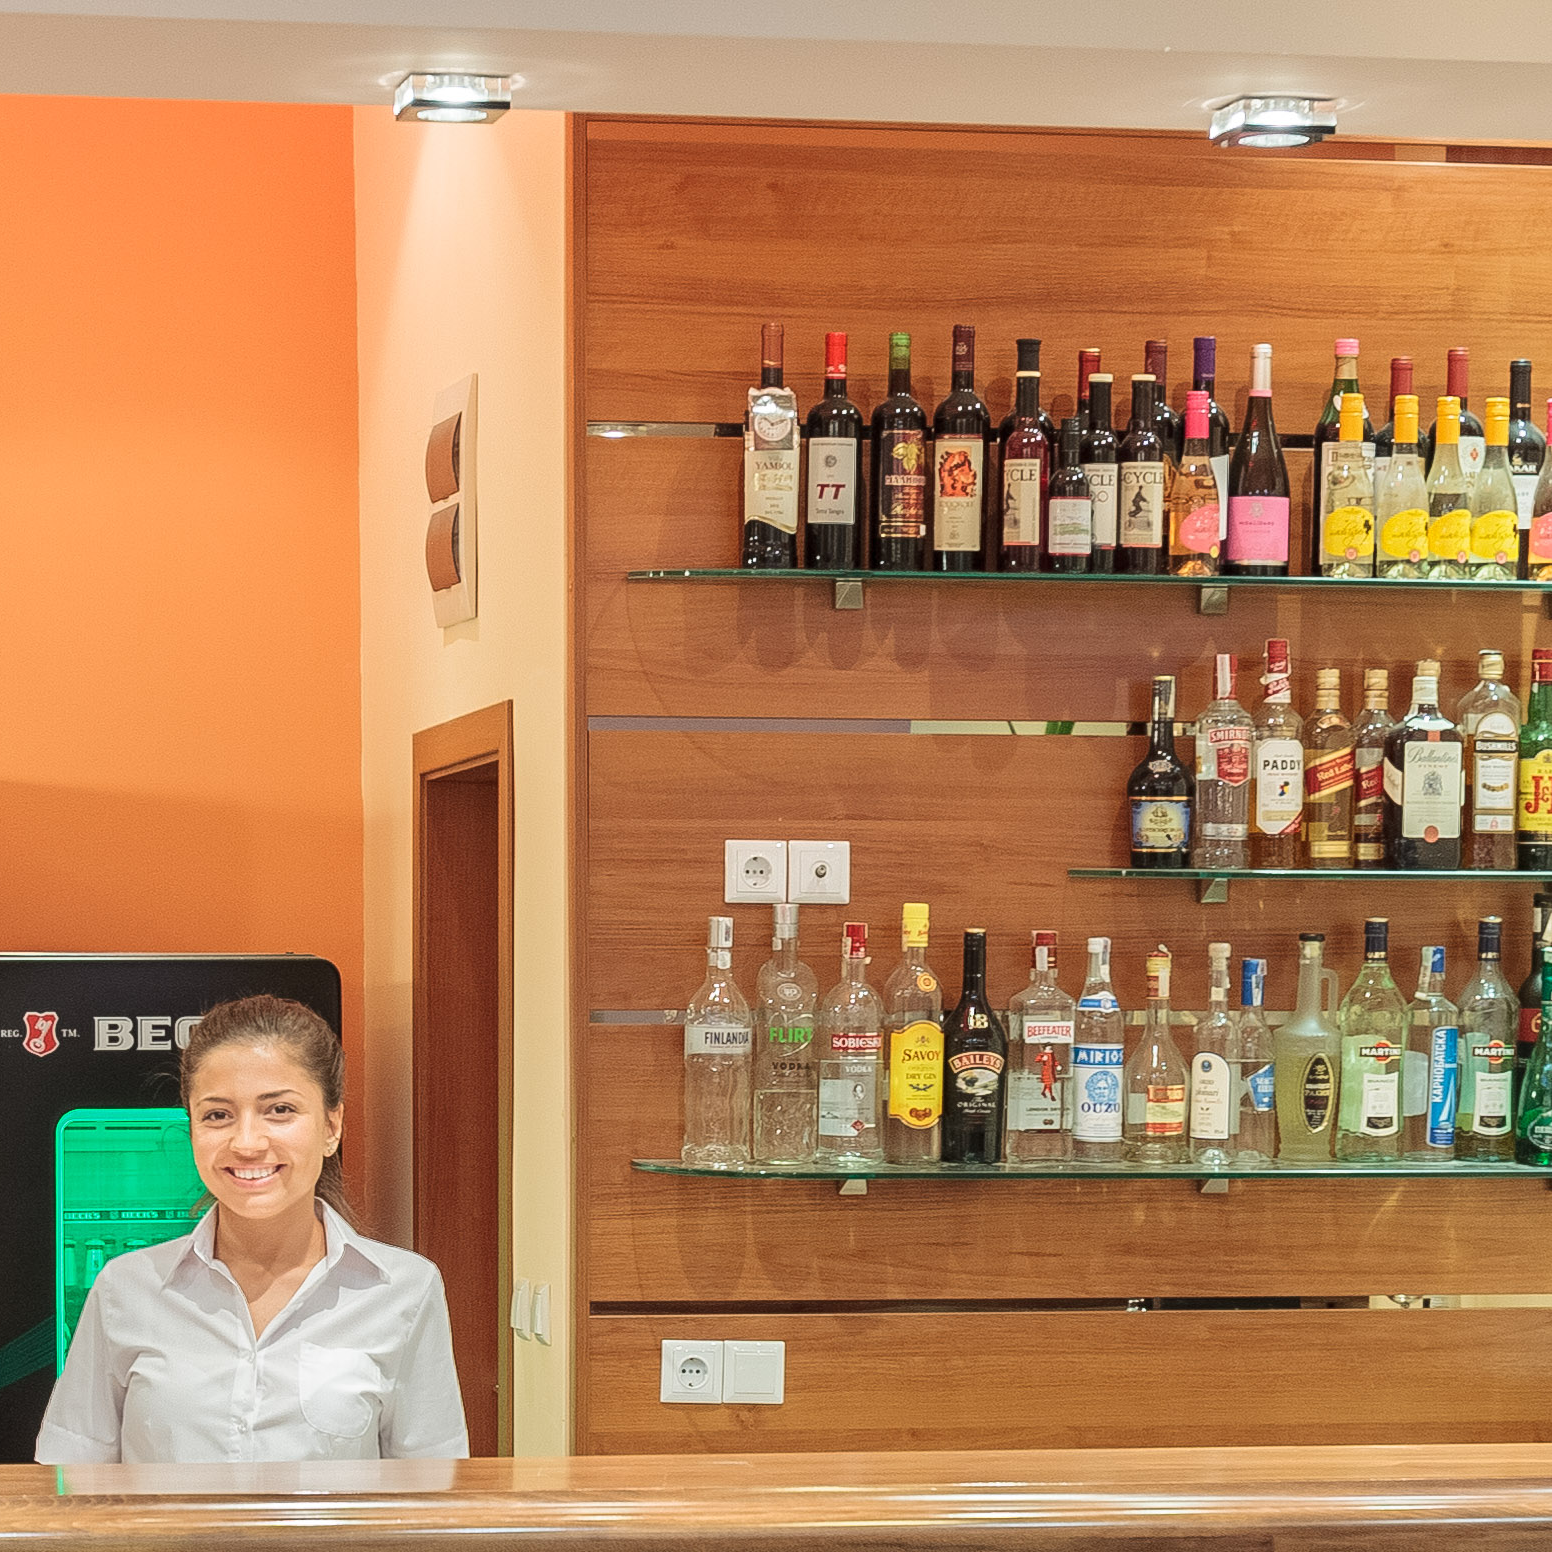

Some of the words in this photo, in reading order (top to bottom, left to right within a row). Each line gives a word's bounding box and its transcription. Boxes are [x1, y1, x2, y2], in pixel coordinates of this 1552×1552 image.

[754, 461, 794, 471] YAMBOL
[1510, 465, 1538, 473] AKAR
[816, 483, 846, 500] TT
[1210, 729, 1250, 742] SMIRNO
[1263, 759, 1301, 770] PADDY
[0, 1029, 23, 1038] REG.
[61, 1028, 81, 1038] TM.
[93, 1016, 205, 1051] BEC
[769, 1027, 813, 1043] FLIRT
[1027, 1025, 1072, 1038] BEEFEATER
[902, 1048, 941, 1063] SAVOY
[1361, 1048, 1401, 1056] MARTINI
[1474, 1048, 1515, 1056] MARTINI
[953, 1054, 1002, 1069] BAILEYS
[1432, 1030, 1447, 1103] КАРНОБАТСКА
